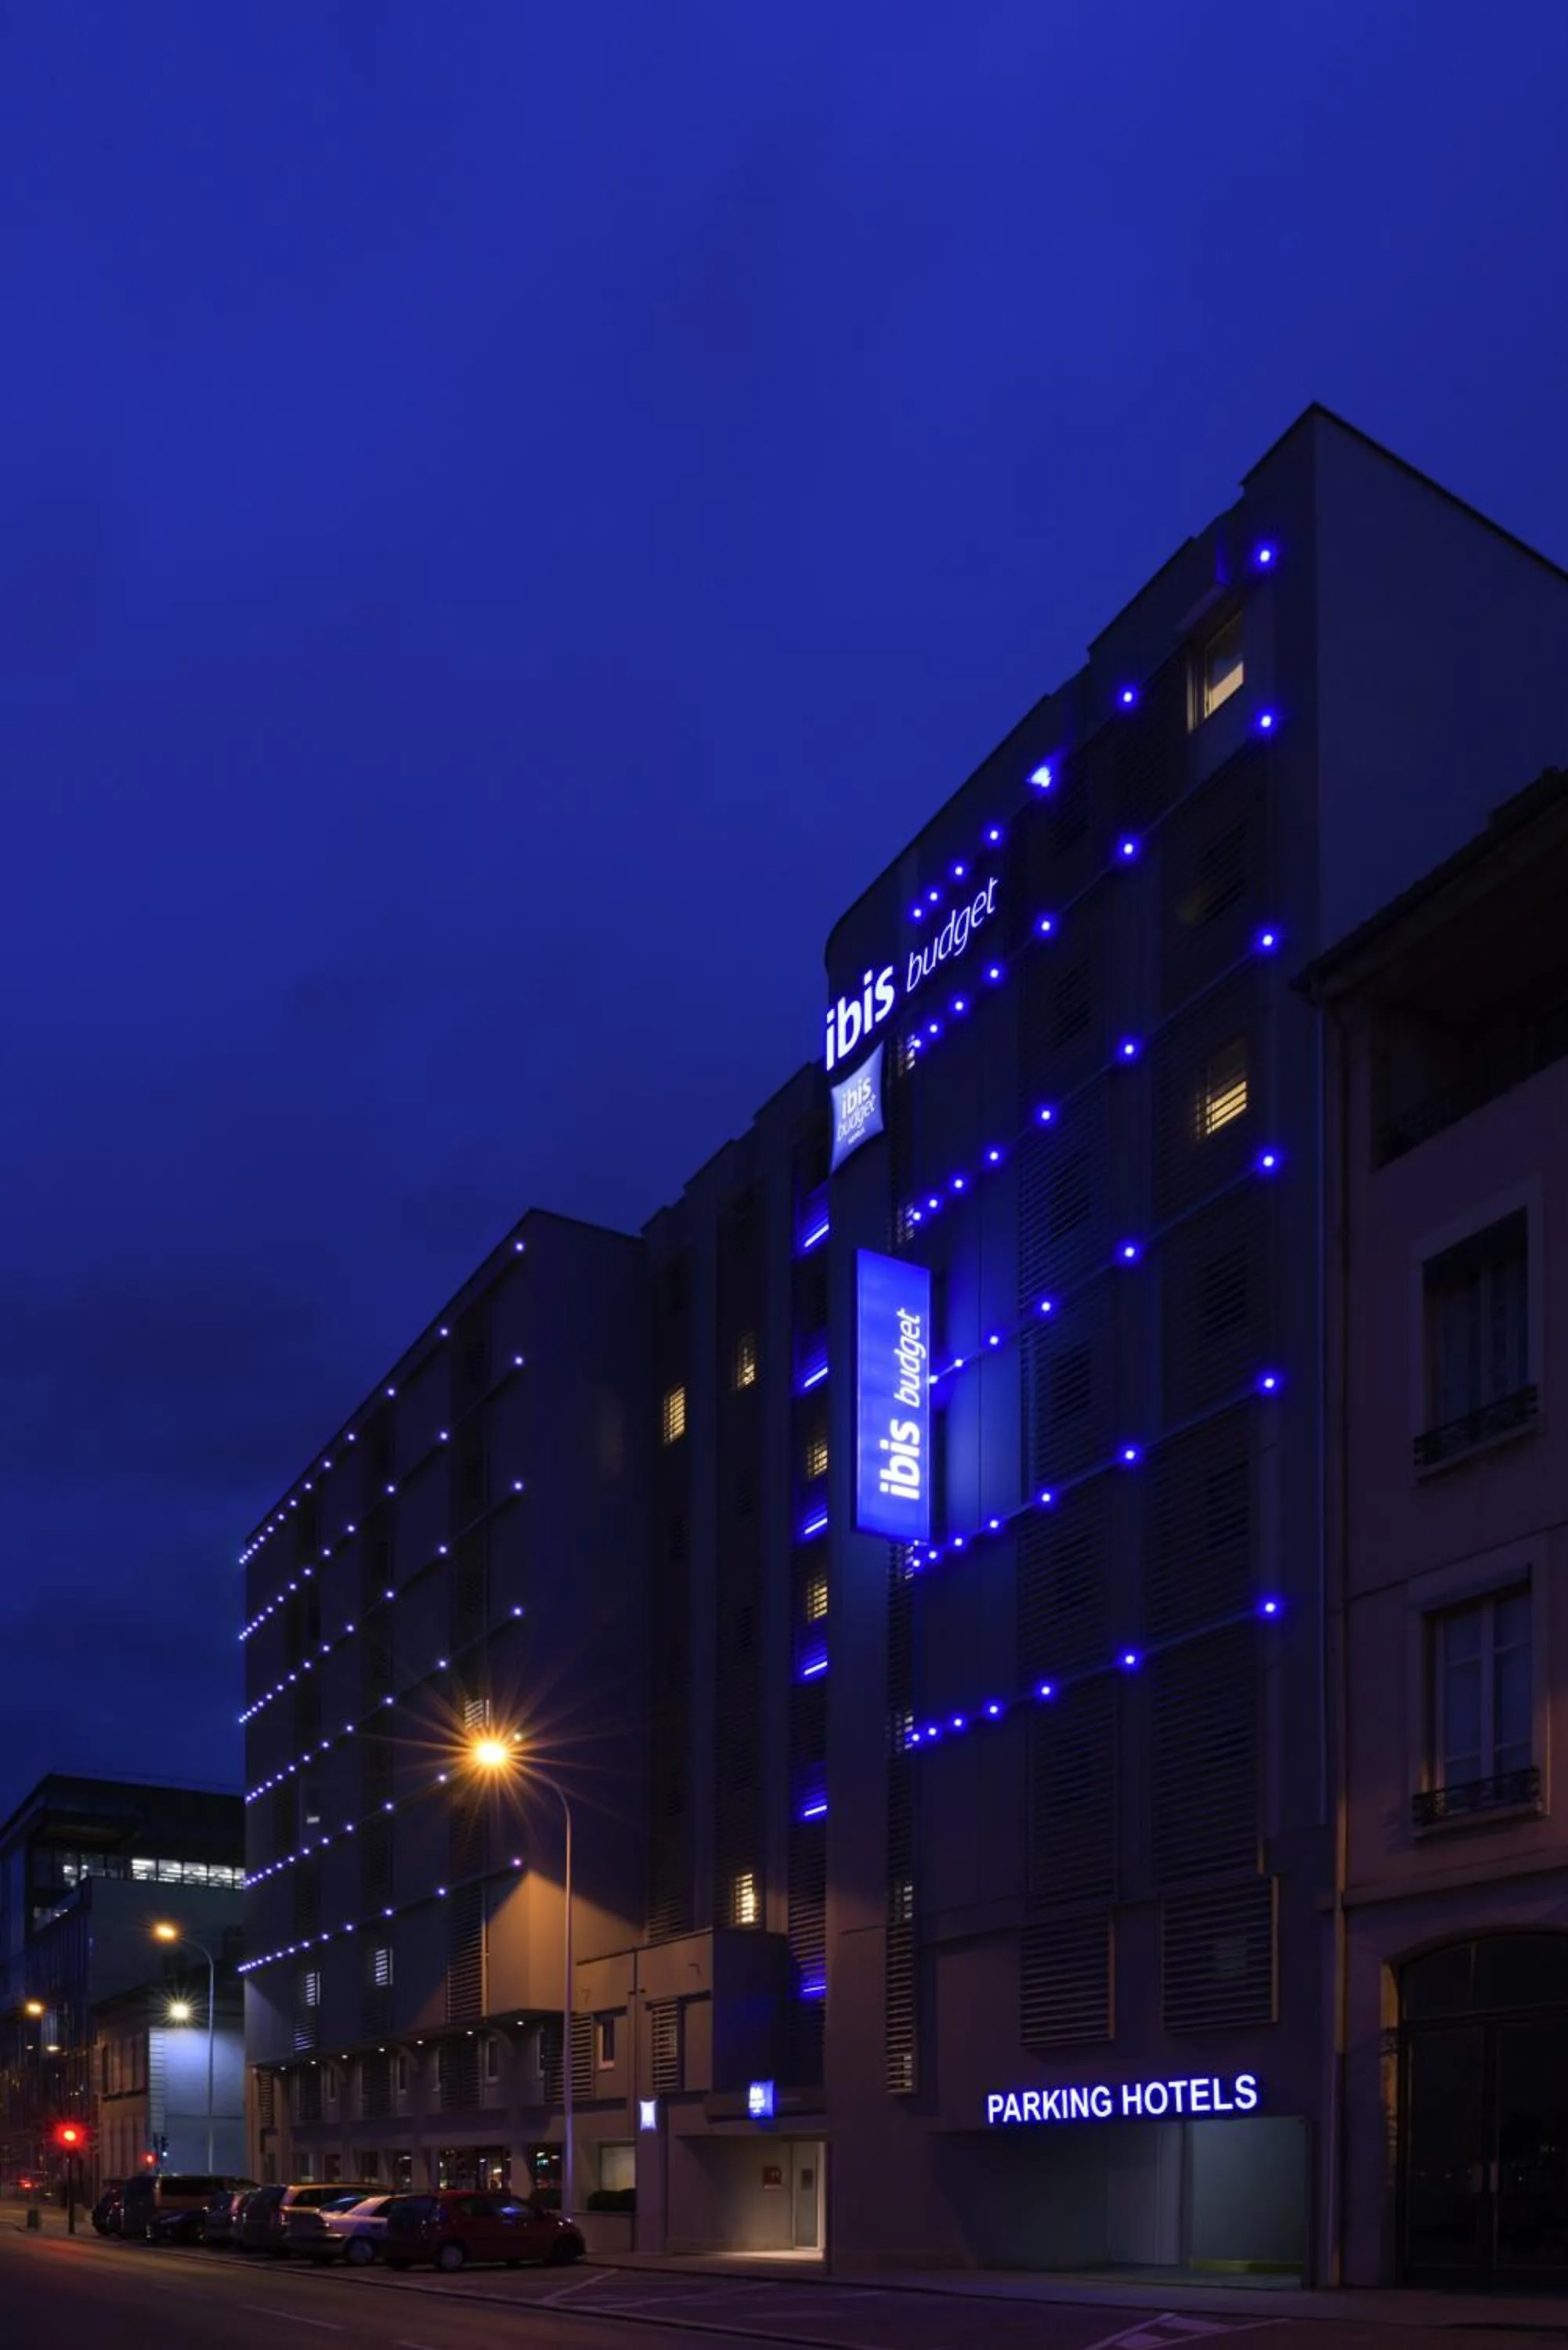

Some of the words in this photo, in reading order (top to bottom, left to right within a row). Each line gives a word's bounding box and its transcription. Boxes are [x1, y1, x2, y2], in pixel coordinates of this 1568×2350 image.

[826, 966, 894, 1071] ibis
[907, 877, 998, 992] budget
[841, 1077, 871, 1119] ibis
[894, 1308, 926, 1408] budget
[879, 1419, 919, 1500] ibis
[988, 2086, 1111, 2124] PARKING
[1122, 2075, 1257, 2115] HOTELS
